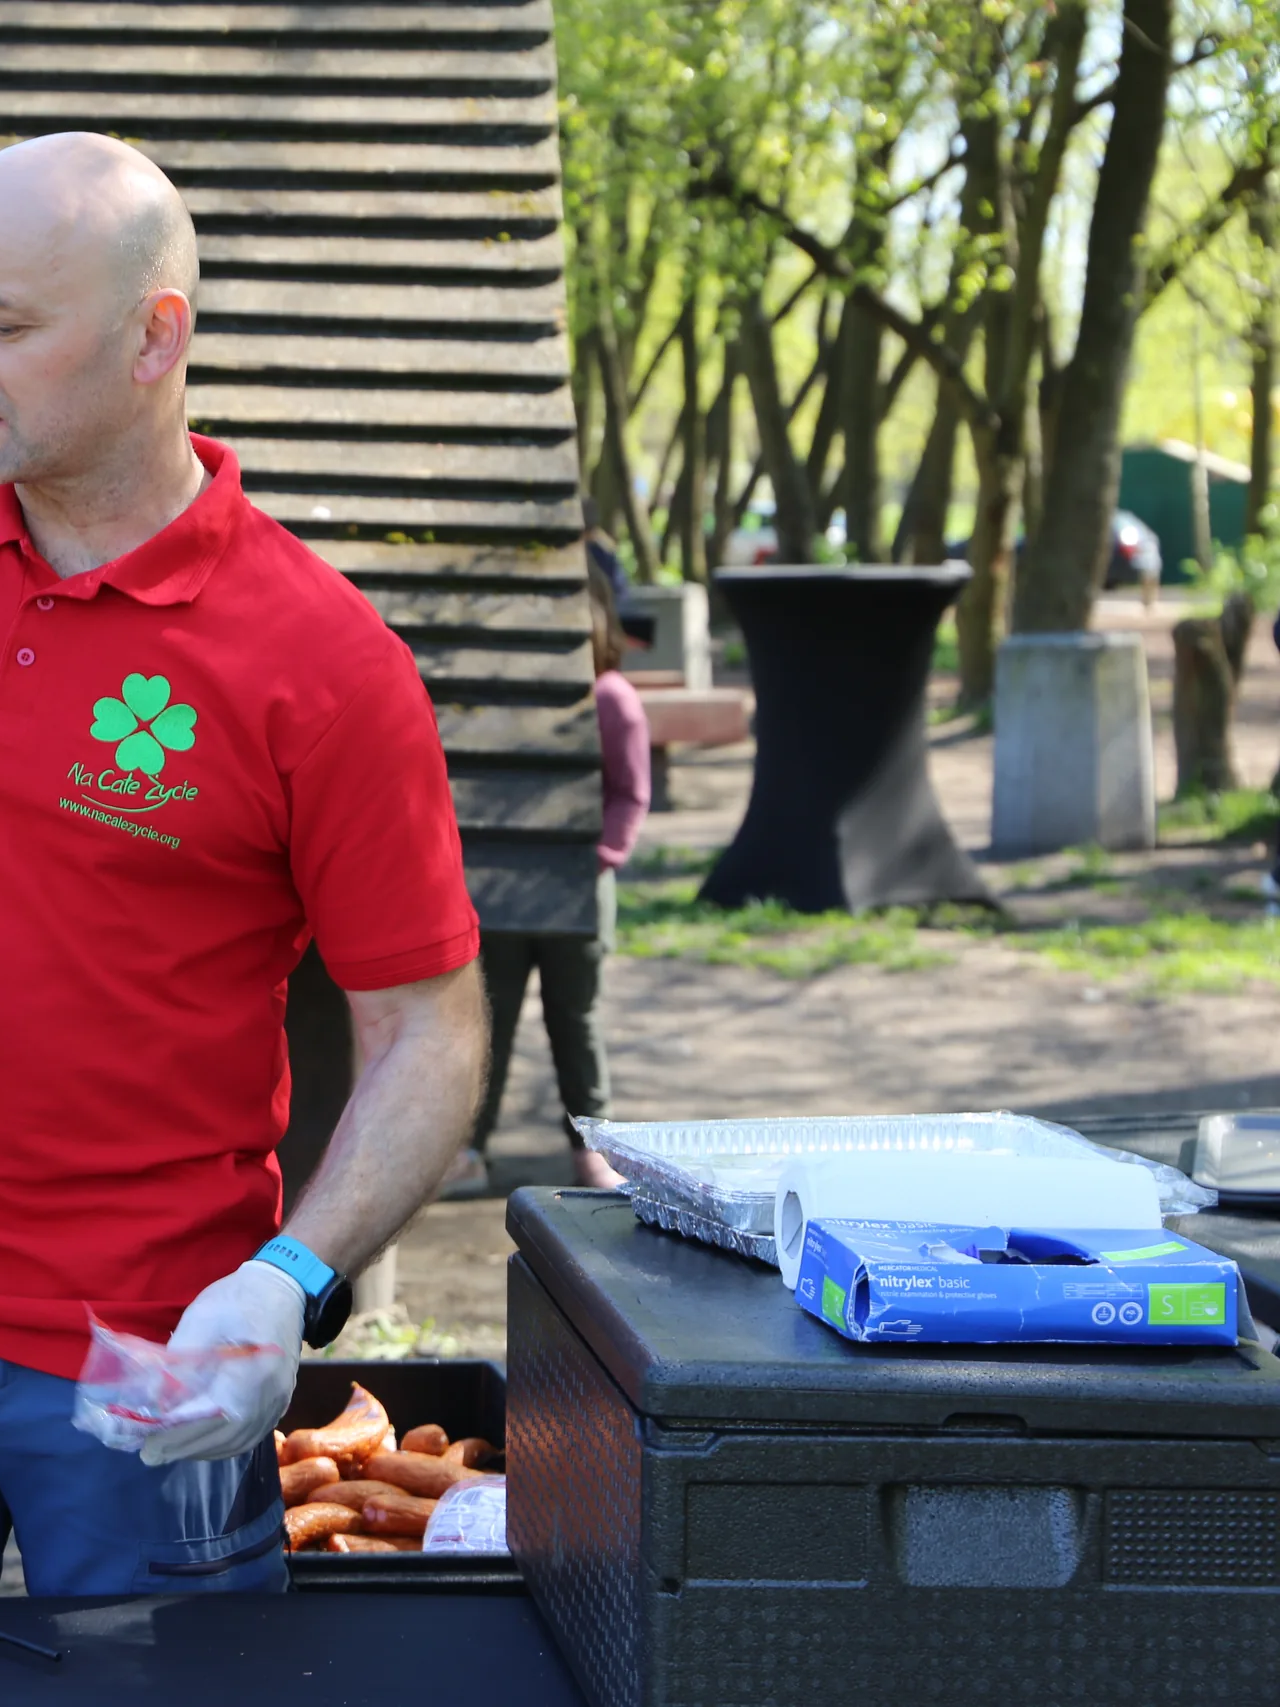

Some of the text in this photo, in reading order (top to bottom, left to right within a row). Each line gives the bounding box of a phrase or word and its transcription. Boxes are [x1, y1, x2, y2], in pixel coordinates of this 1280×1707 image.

[67, 762, 199, 802] Na Całe Życie
[59, 797, 181, 850] www.nacalezycie.org
[938, 1275, 971, 1289] basic
[945, 1291, 976, 1299] protective
[977, 1292, 997, 1300] gloves
[1161, 1294, 1175, 1315] S
